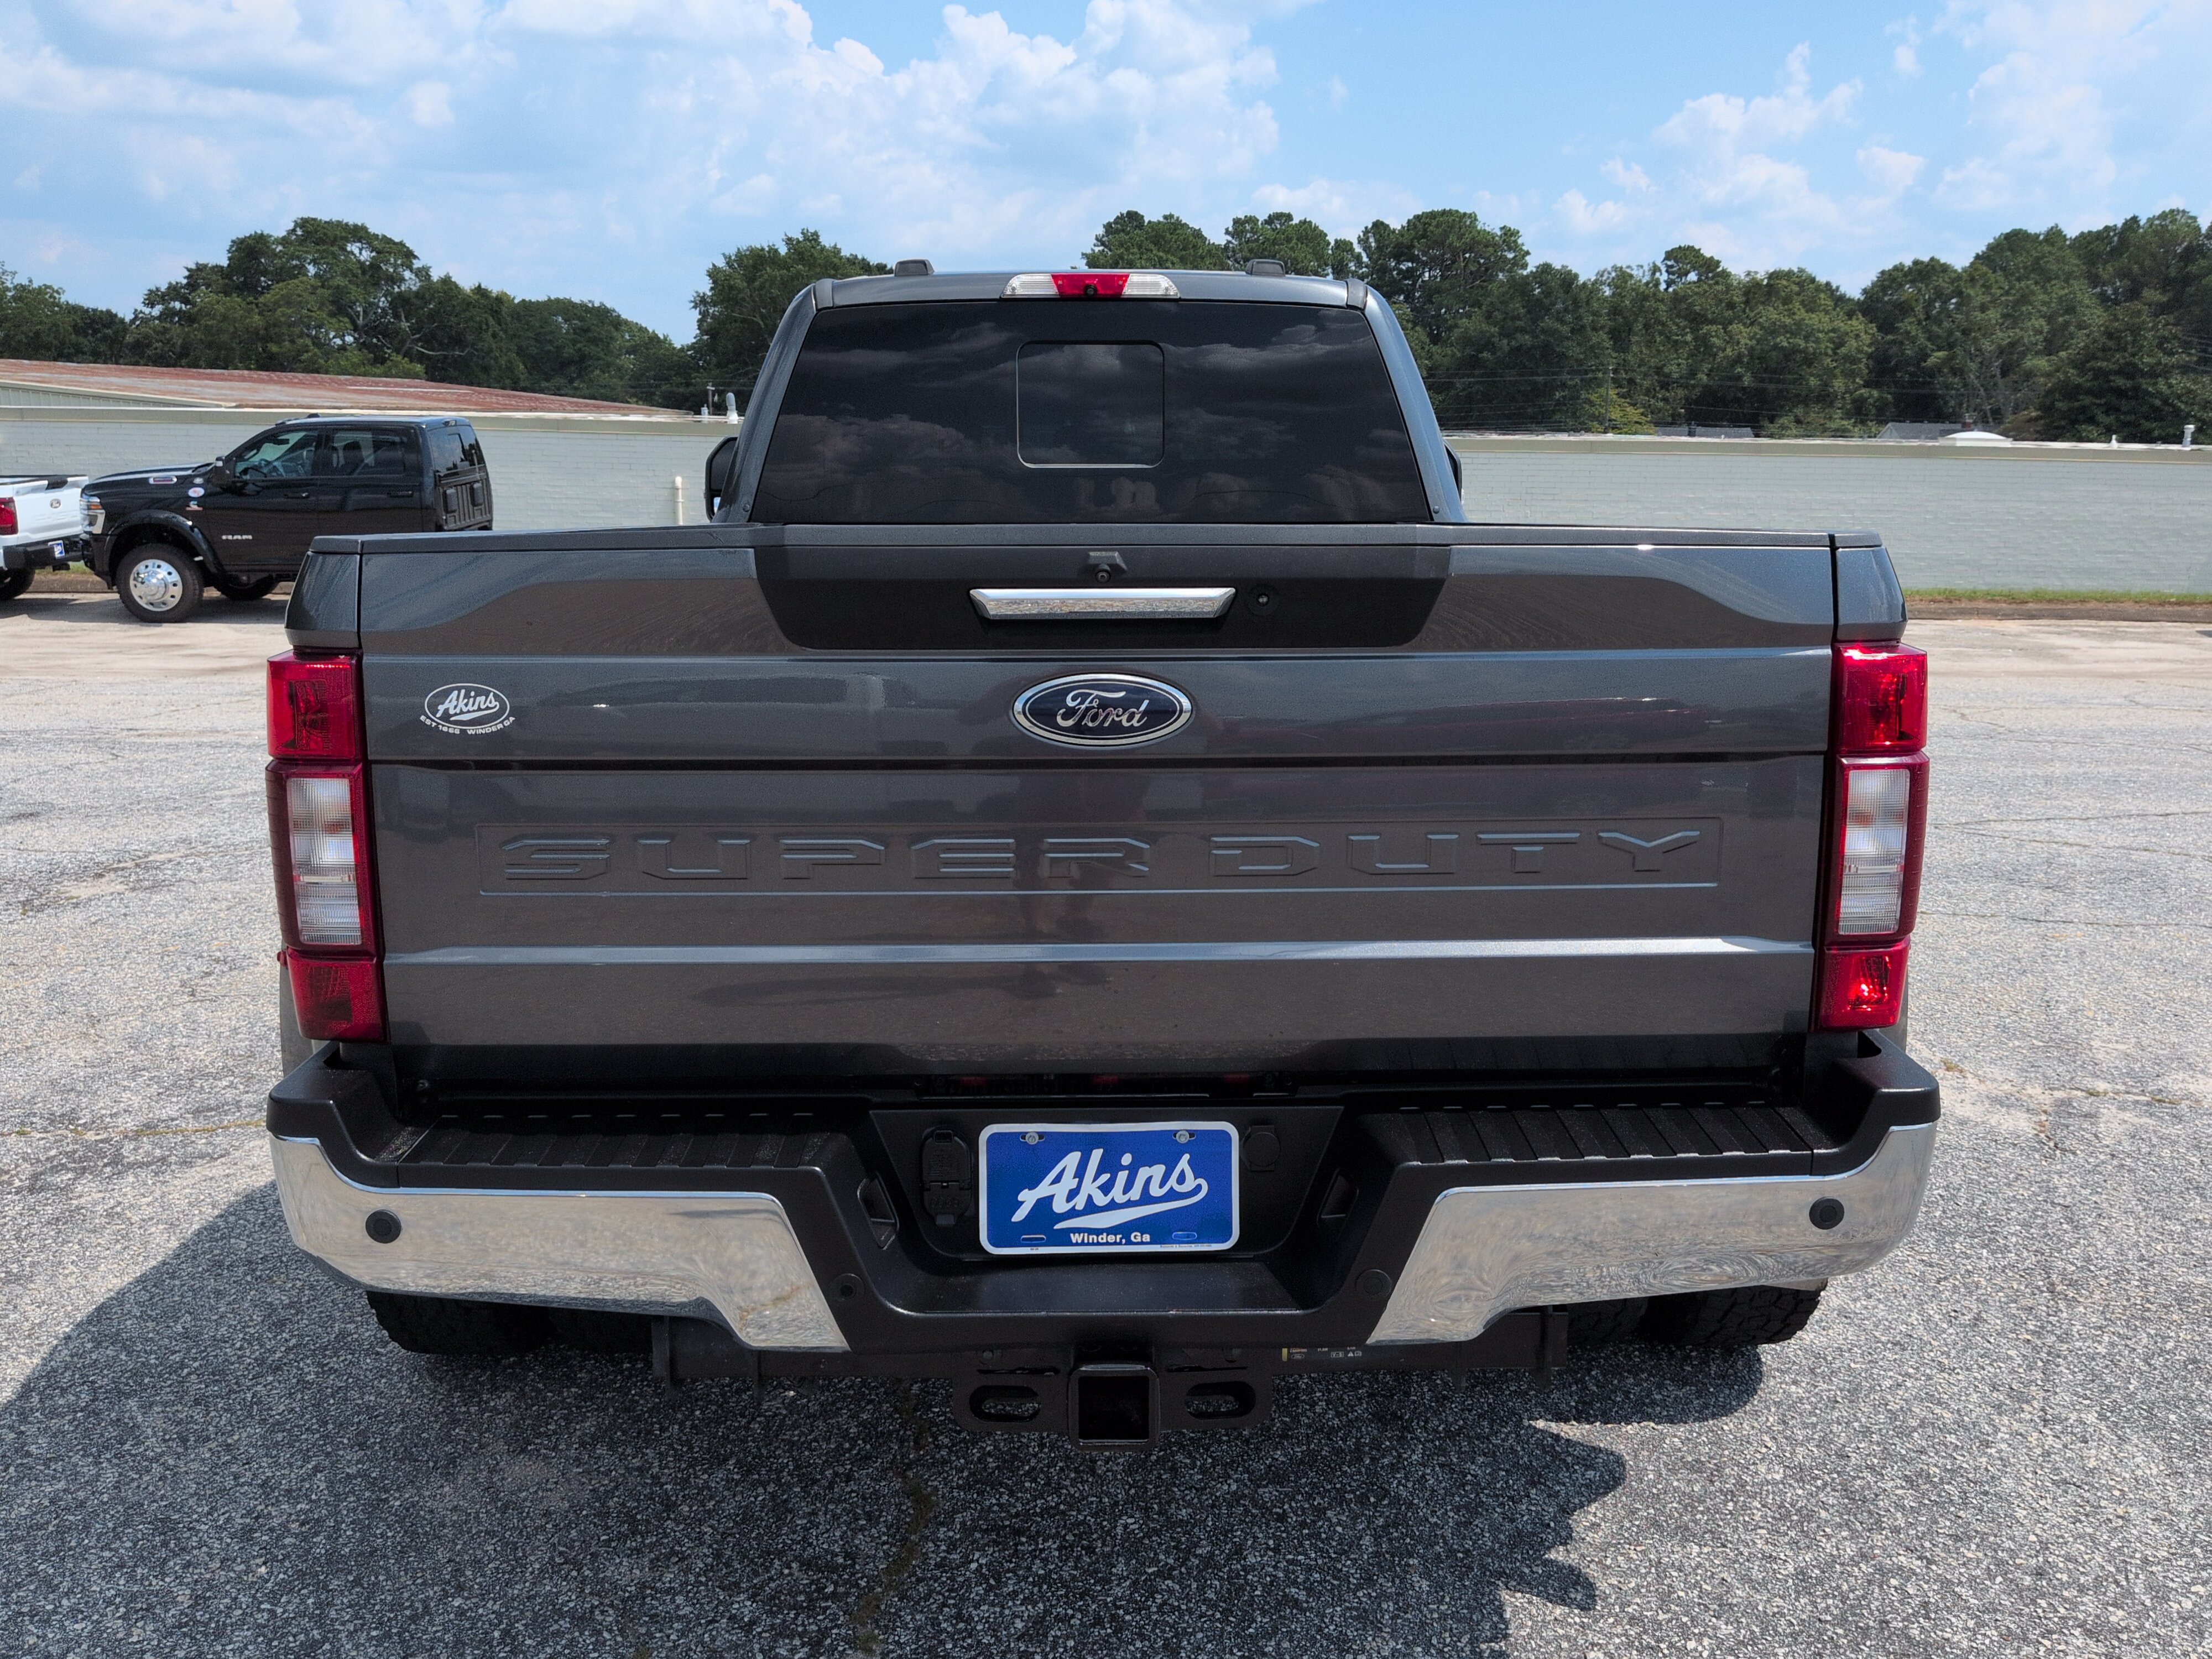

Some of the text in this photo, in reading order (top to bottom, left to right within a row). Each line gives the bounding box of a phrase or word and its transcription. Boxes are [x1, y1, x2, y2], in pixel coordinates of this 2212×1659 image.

[436, 689, 499, 721] Akins
[1056, 689, 1149, 727] Ford
[466, 723, 504, 734] WINDER
[503, 717, 515, 726] GA
[500, 830, 1702, 881] SUPER DUTY
[1011, 1148, 1208, 1229] Akins
[1070, 1233, 1151, 1244] Winder, Ga
